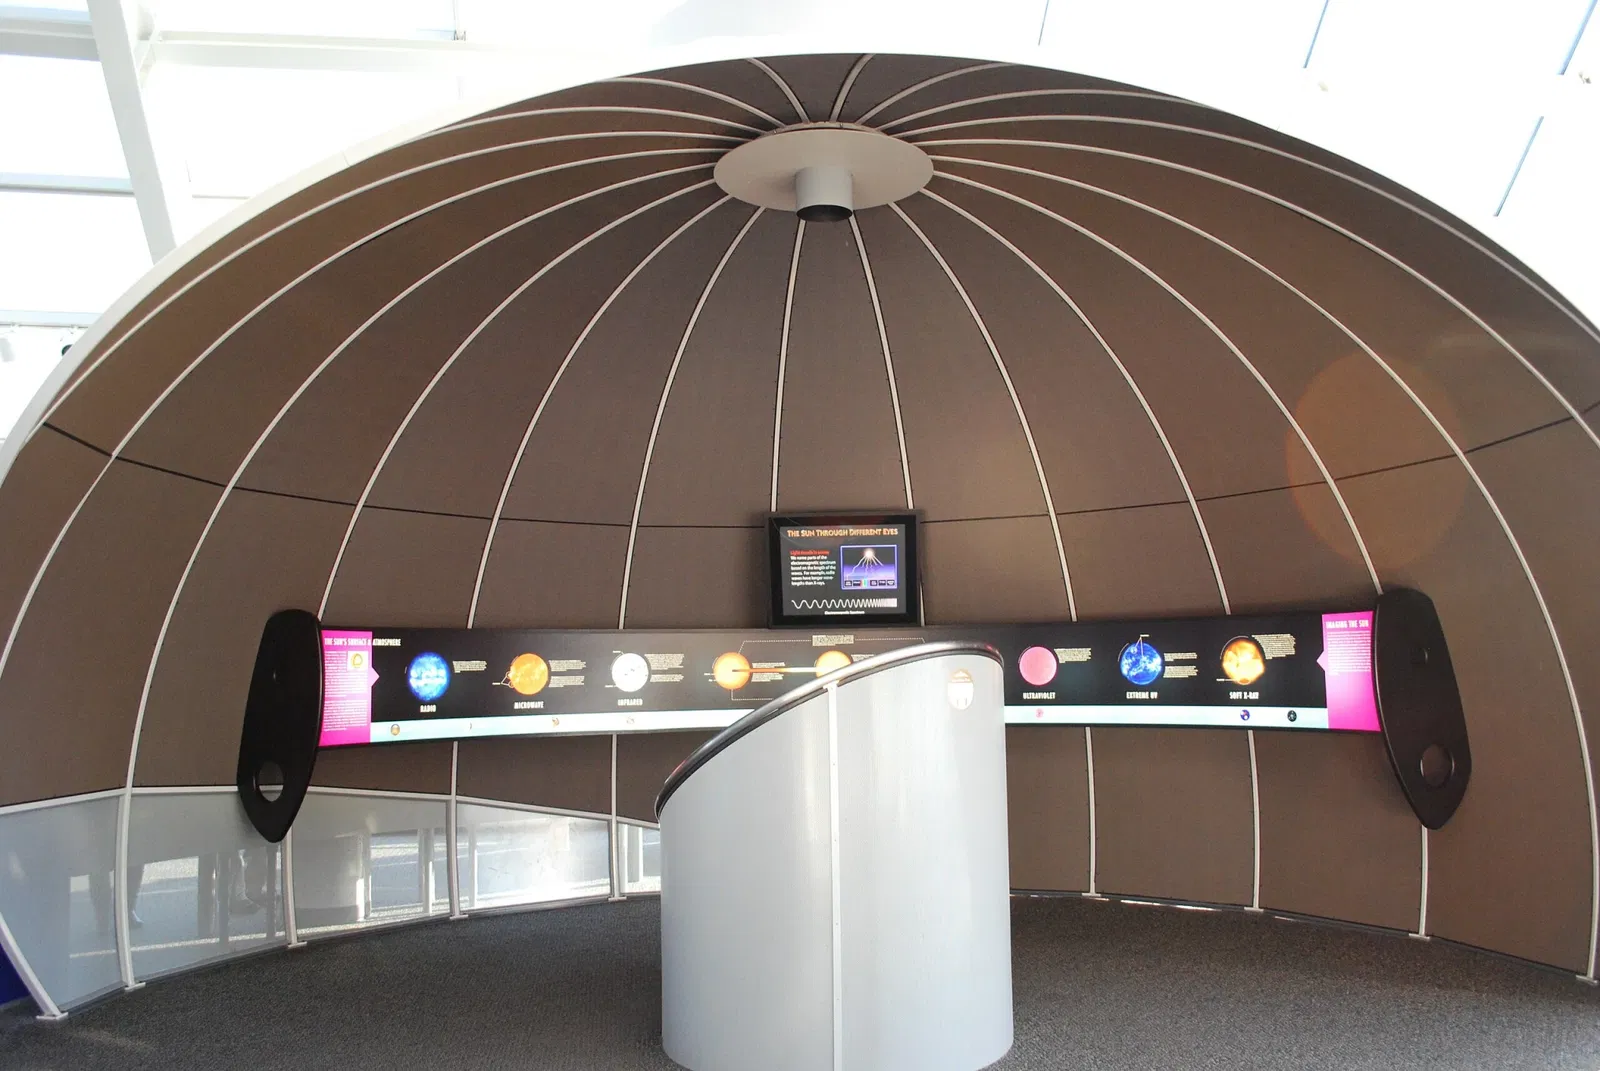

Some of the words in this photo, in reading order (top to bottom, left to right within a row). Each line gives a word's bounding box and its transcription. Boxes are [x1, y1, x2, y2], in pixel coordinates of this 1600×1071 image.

[816, 529, 848, 537] THROUGH
[1326, 620, 1348, 628] IMAGING
[1348, 620, 1358, 628] THE
[1358, 620, 1369, 628] SUN
[324, 638, 333, 646] THE
[334, 638, 347, 646] SUN'S
[420, 704, 436, 712] RADIO
[514, 701, 544, 709] MICROWAVE
